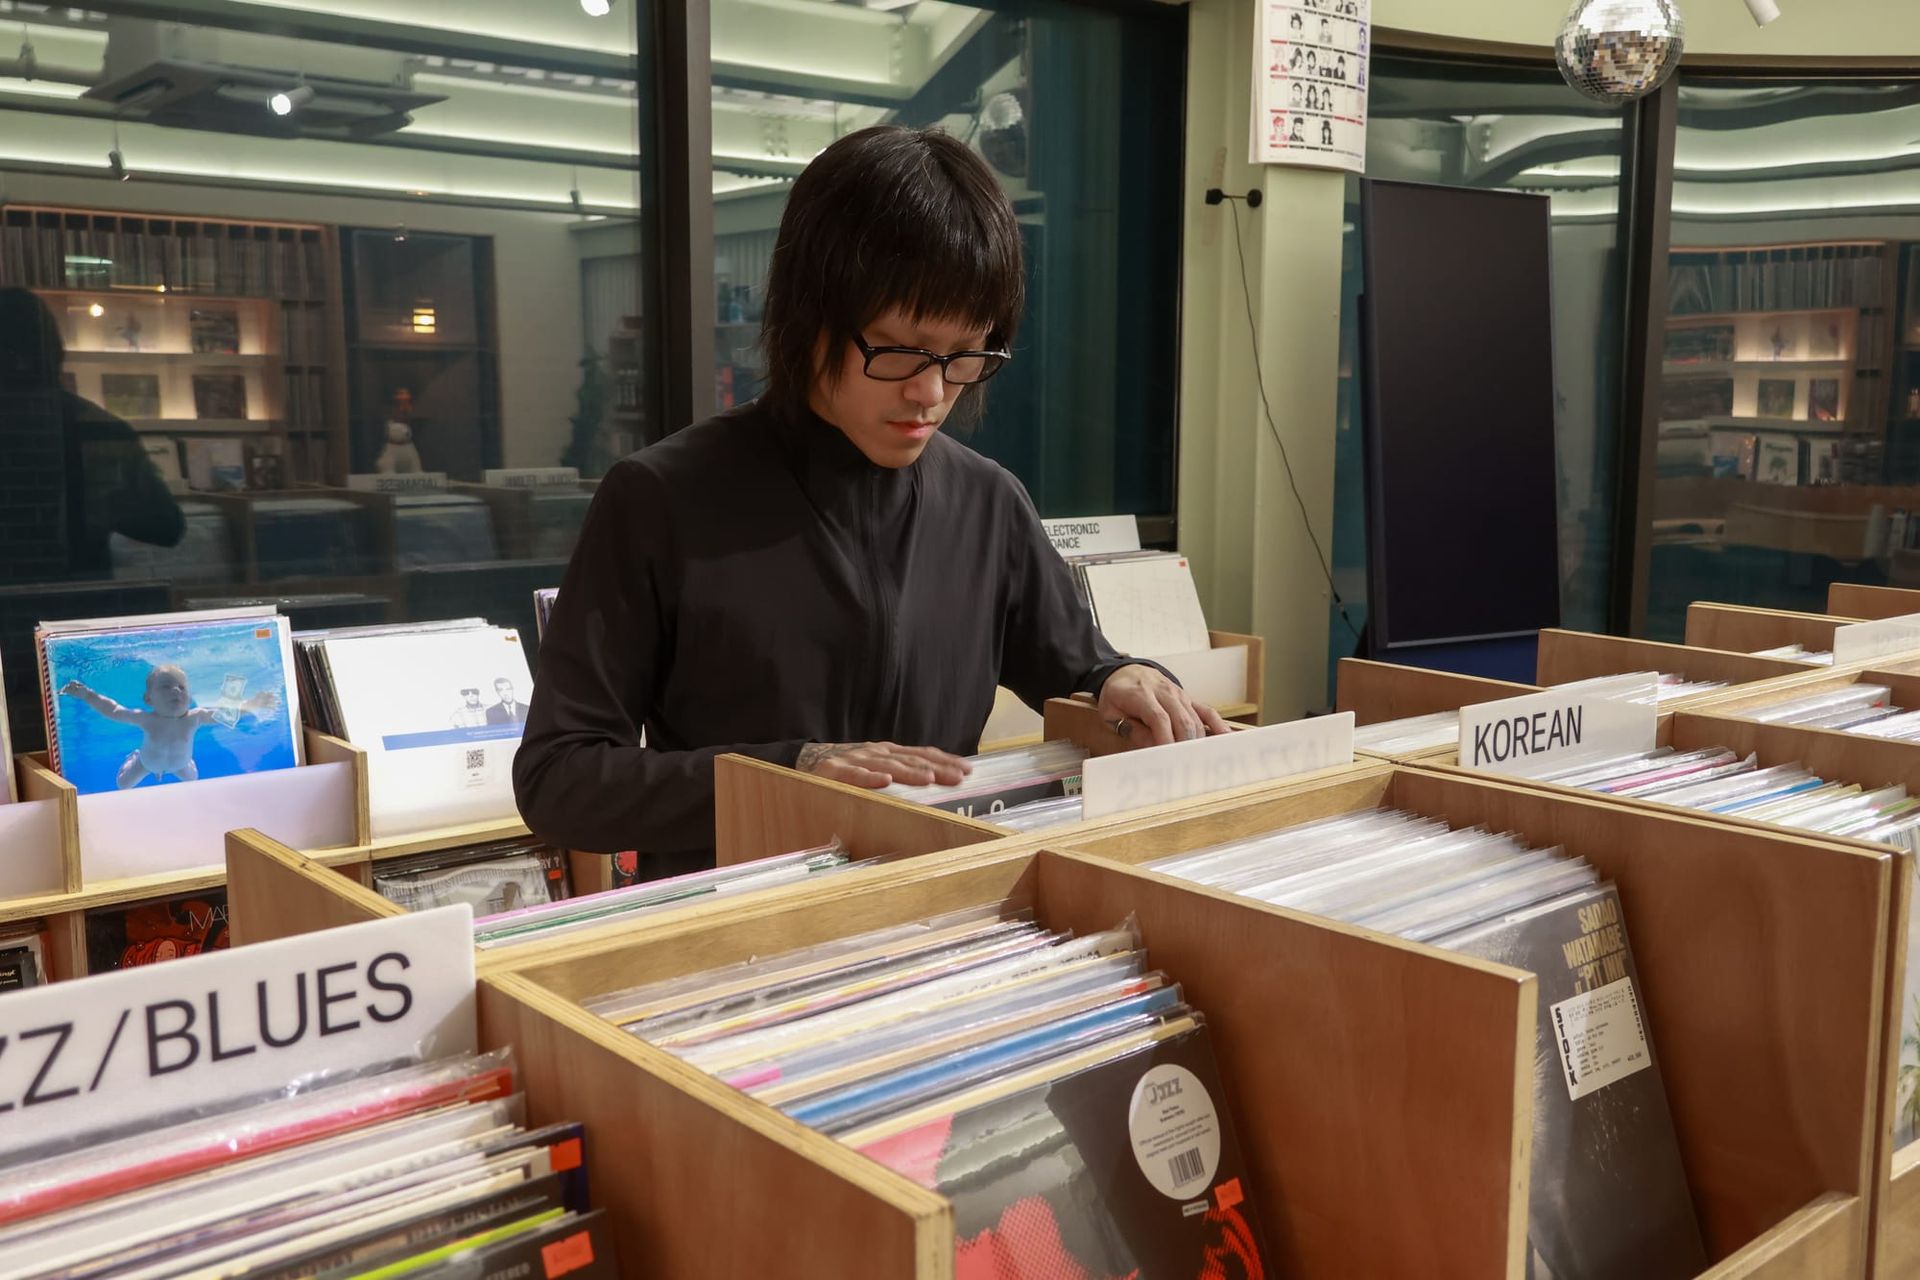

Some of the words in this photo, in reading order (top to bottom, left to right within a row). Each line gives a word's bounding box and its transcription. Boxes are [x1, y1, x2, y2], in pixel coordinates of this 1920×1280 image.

[1474, 705, 1582, 766] KOREAN
[1578, 898, 1618, 933] SADAO
[1562, 923, 1625, 970] WATANABE
[0, 952, 413, 1111] Z/BLUES
